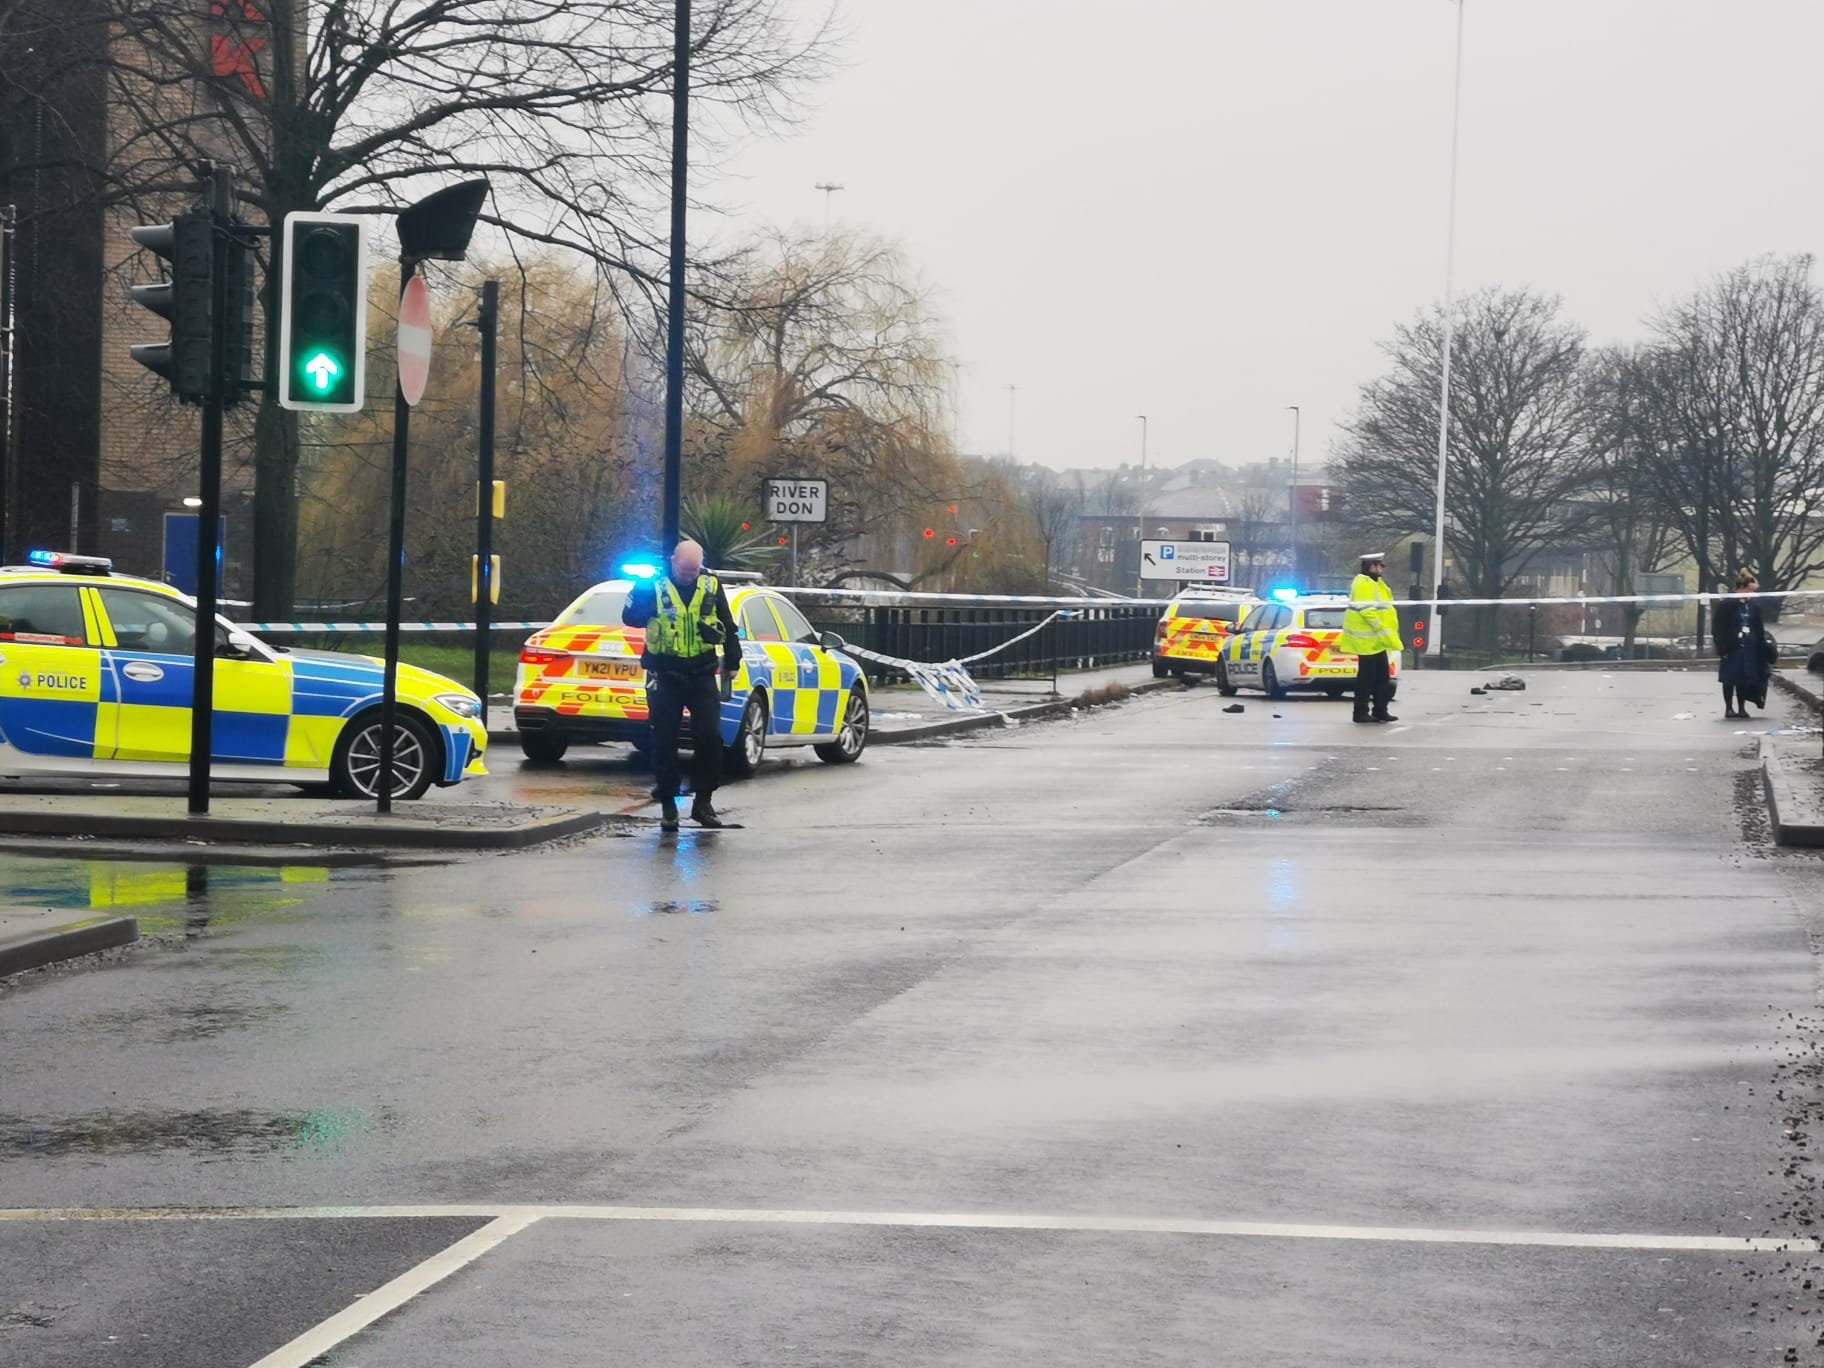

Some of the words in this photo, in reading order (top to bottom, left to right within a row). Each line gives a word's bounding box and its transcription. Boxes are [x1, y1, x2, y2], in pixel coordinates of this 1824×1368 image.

[770, 486, 819, 498] RIVER
[776, 502, 813, 515] DON
[1162, 546, 1173, 559] P
[1177, 553, 1226, 563] multi-storey
[1176, 566, 1206, 574] Station
[615, 664, 638, 677] VPU
[1228, 662, 1259, 675] POLICE
[37, 674, 87, 690] POLICE
[561, 692, 648, 706] POLICE
